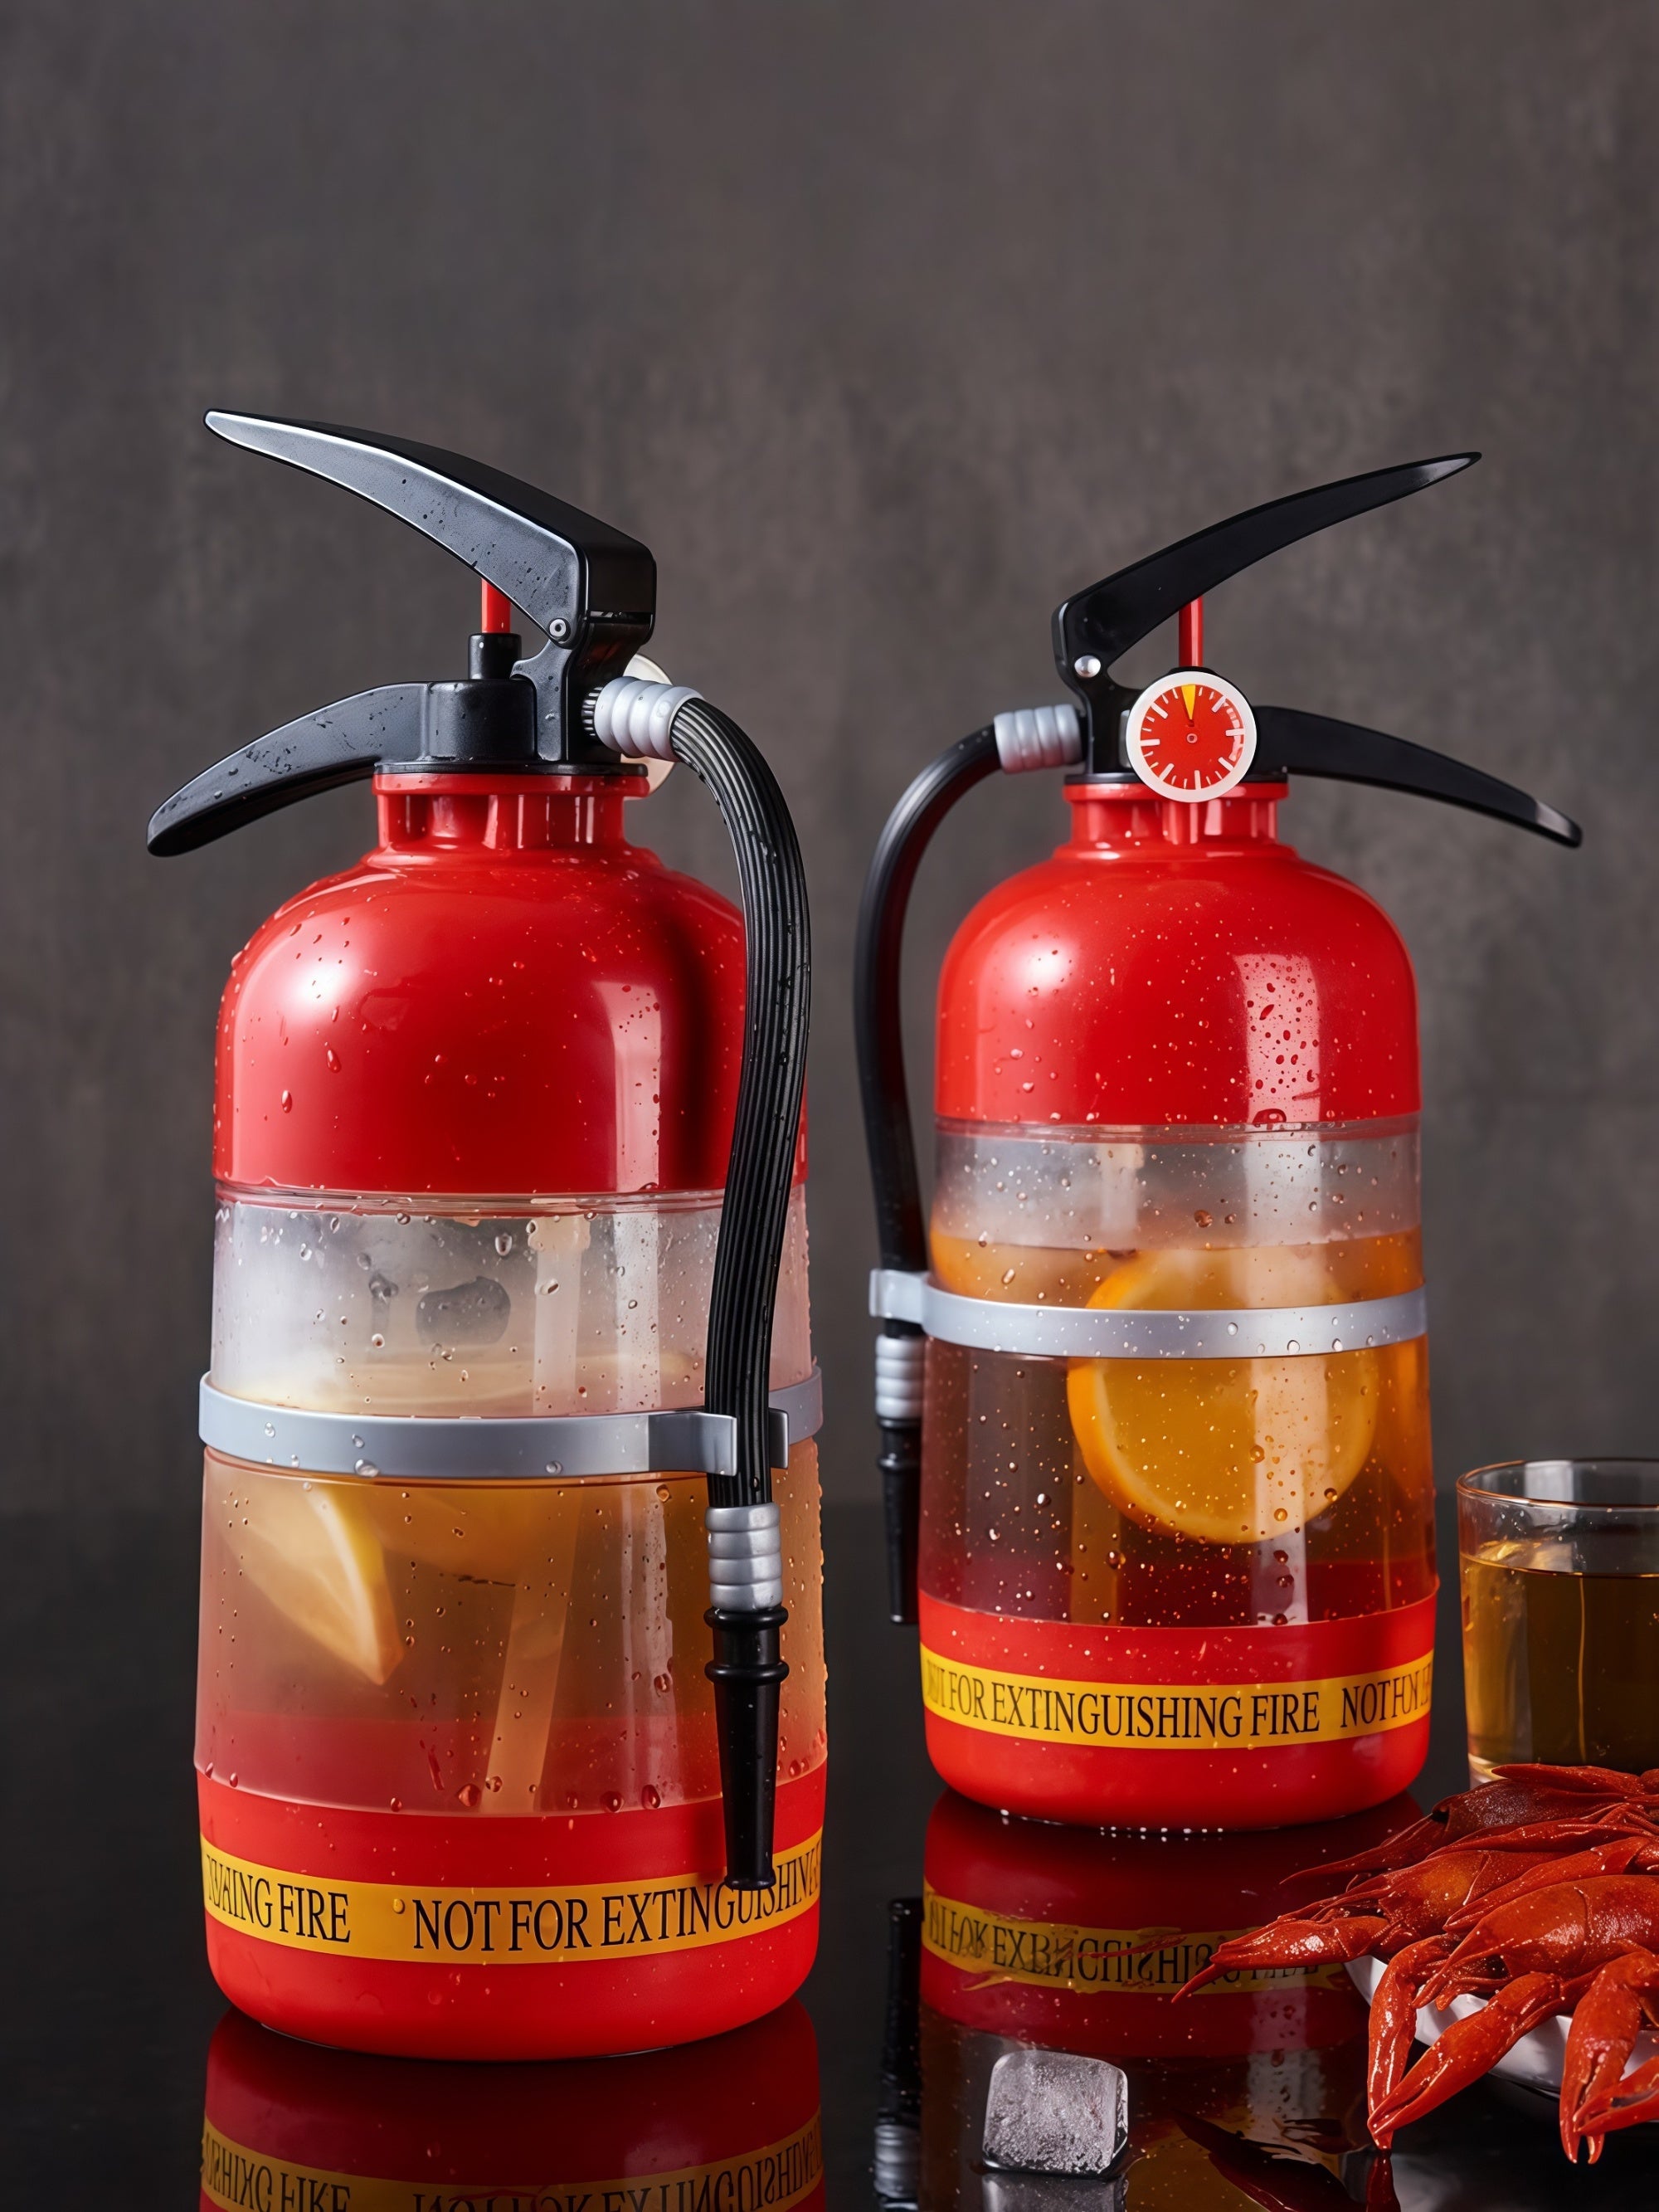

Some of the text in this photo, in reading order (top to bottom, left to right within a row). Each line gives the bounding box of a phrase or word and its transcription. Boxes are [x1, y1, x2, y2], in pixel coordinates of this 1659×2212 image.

[948, 1671, 987, 1720] FOR
[991, 1682, 1243, 1739] EXTINGUISHING
[1250, 1692, 1321, 1737] FIRE
[1340, 1680, 1391, 1728] NOT
[277, 1883, 351, 1944] FIRE
[412, 1898, 501, 1951] NOT
[508, 1898, 592, 1951] FOR
